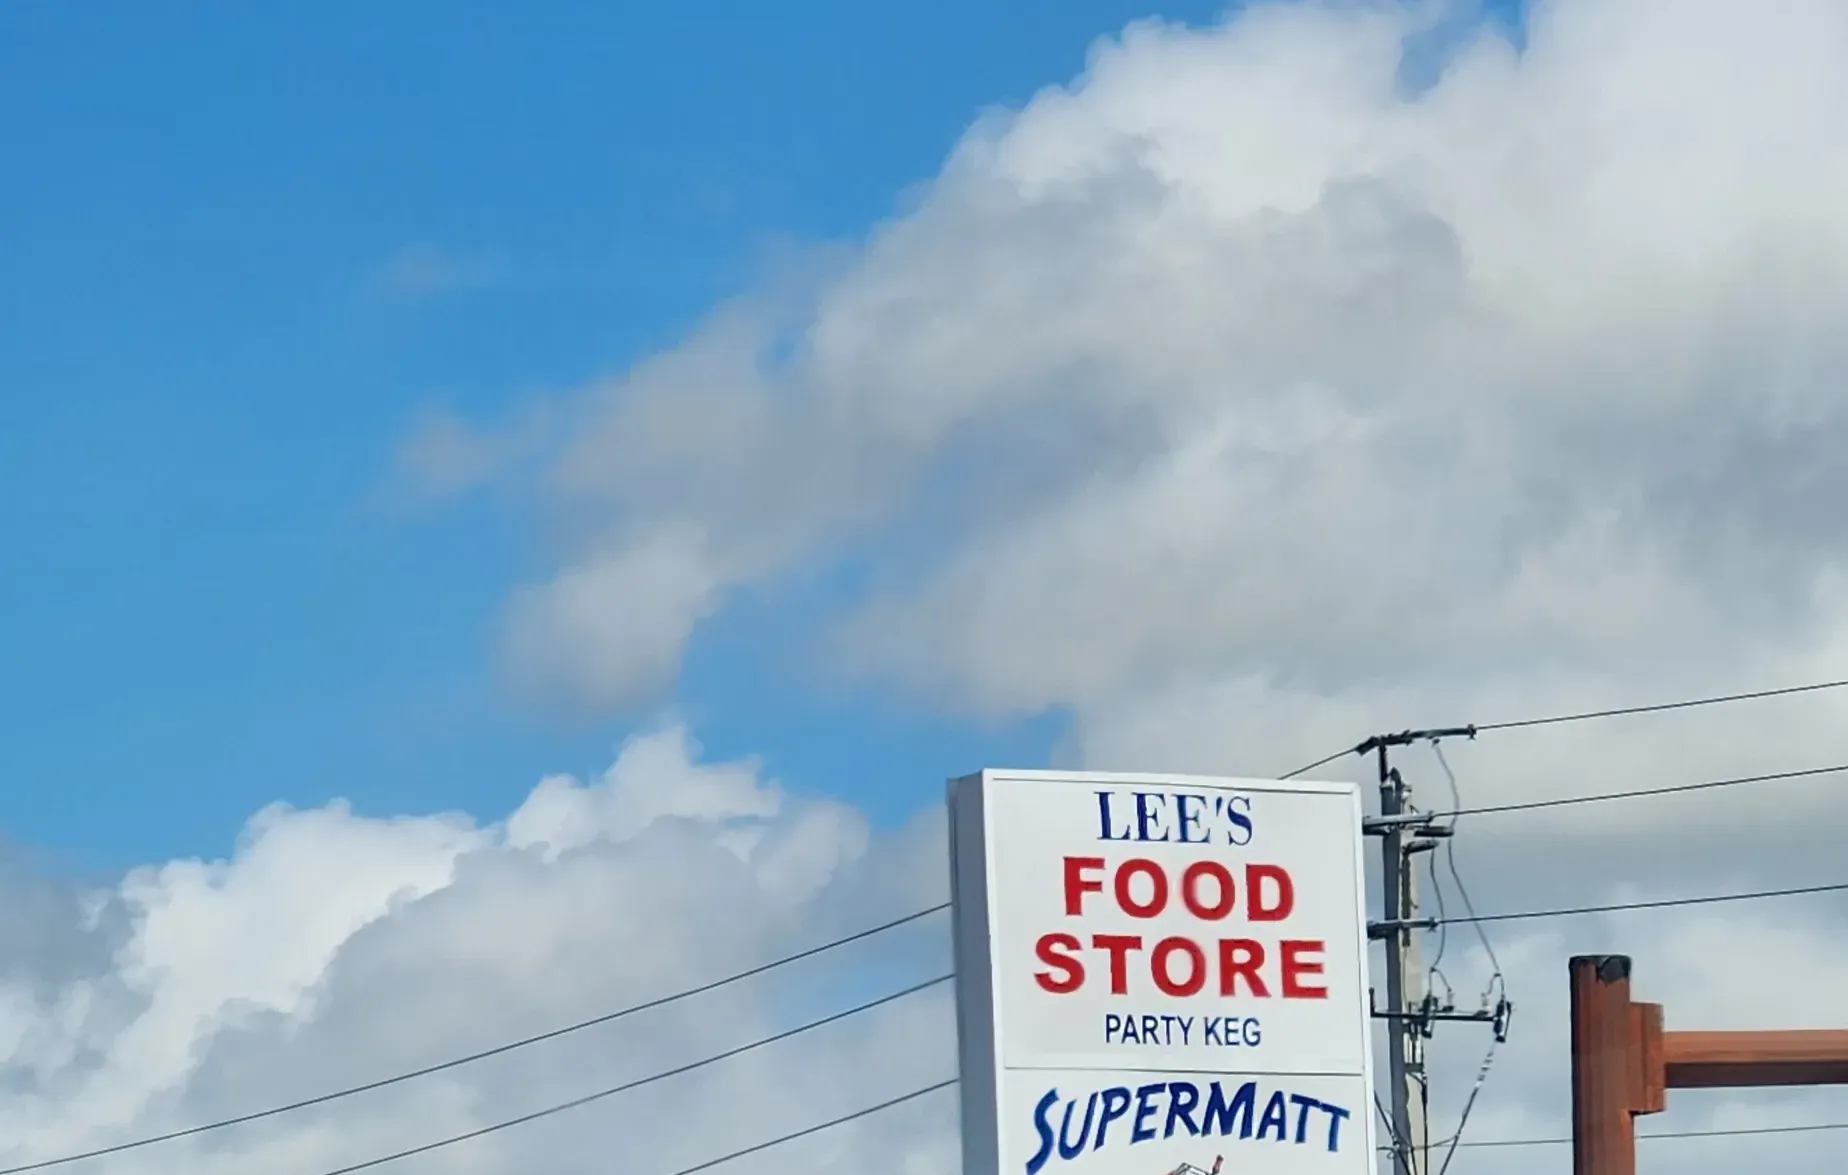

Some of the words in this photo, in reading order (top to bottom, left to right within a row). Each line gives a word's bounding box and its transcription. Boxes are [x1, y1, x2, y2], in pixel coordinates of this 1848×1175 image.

[1094, 791, 1253, 846] LEE'S
[1063, 856, 1294, 922] FOOD
[1033, 932, 1328, 999] STORE
[1105, 1013, 1192, 1046] PARTY
[1203, 1015, 1262, 1047] KEG
